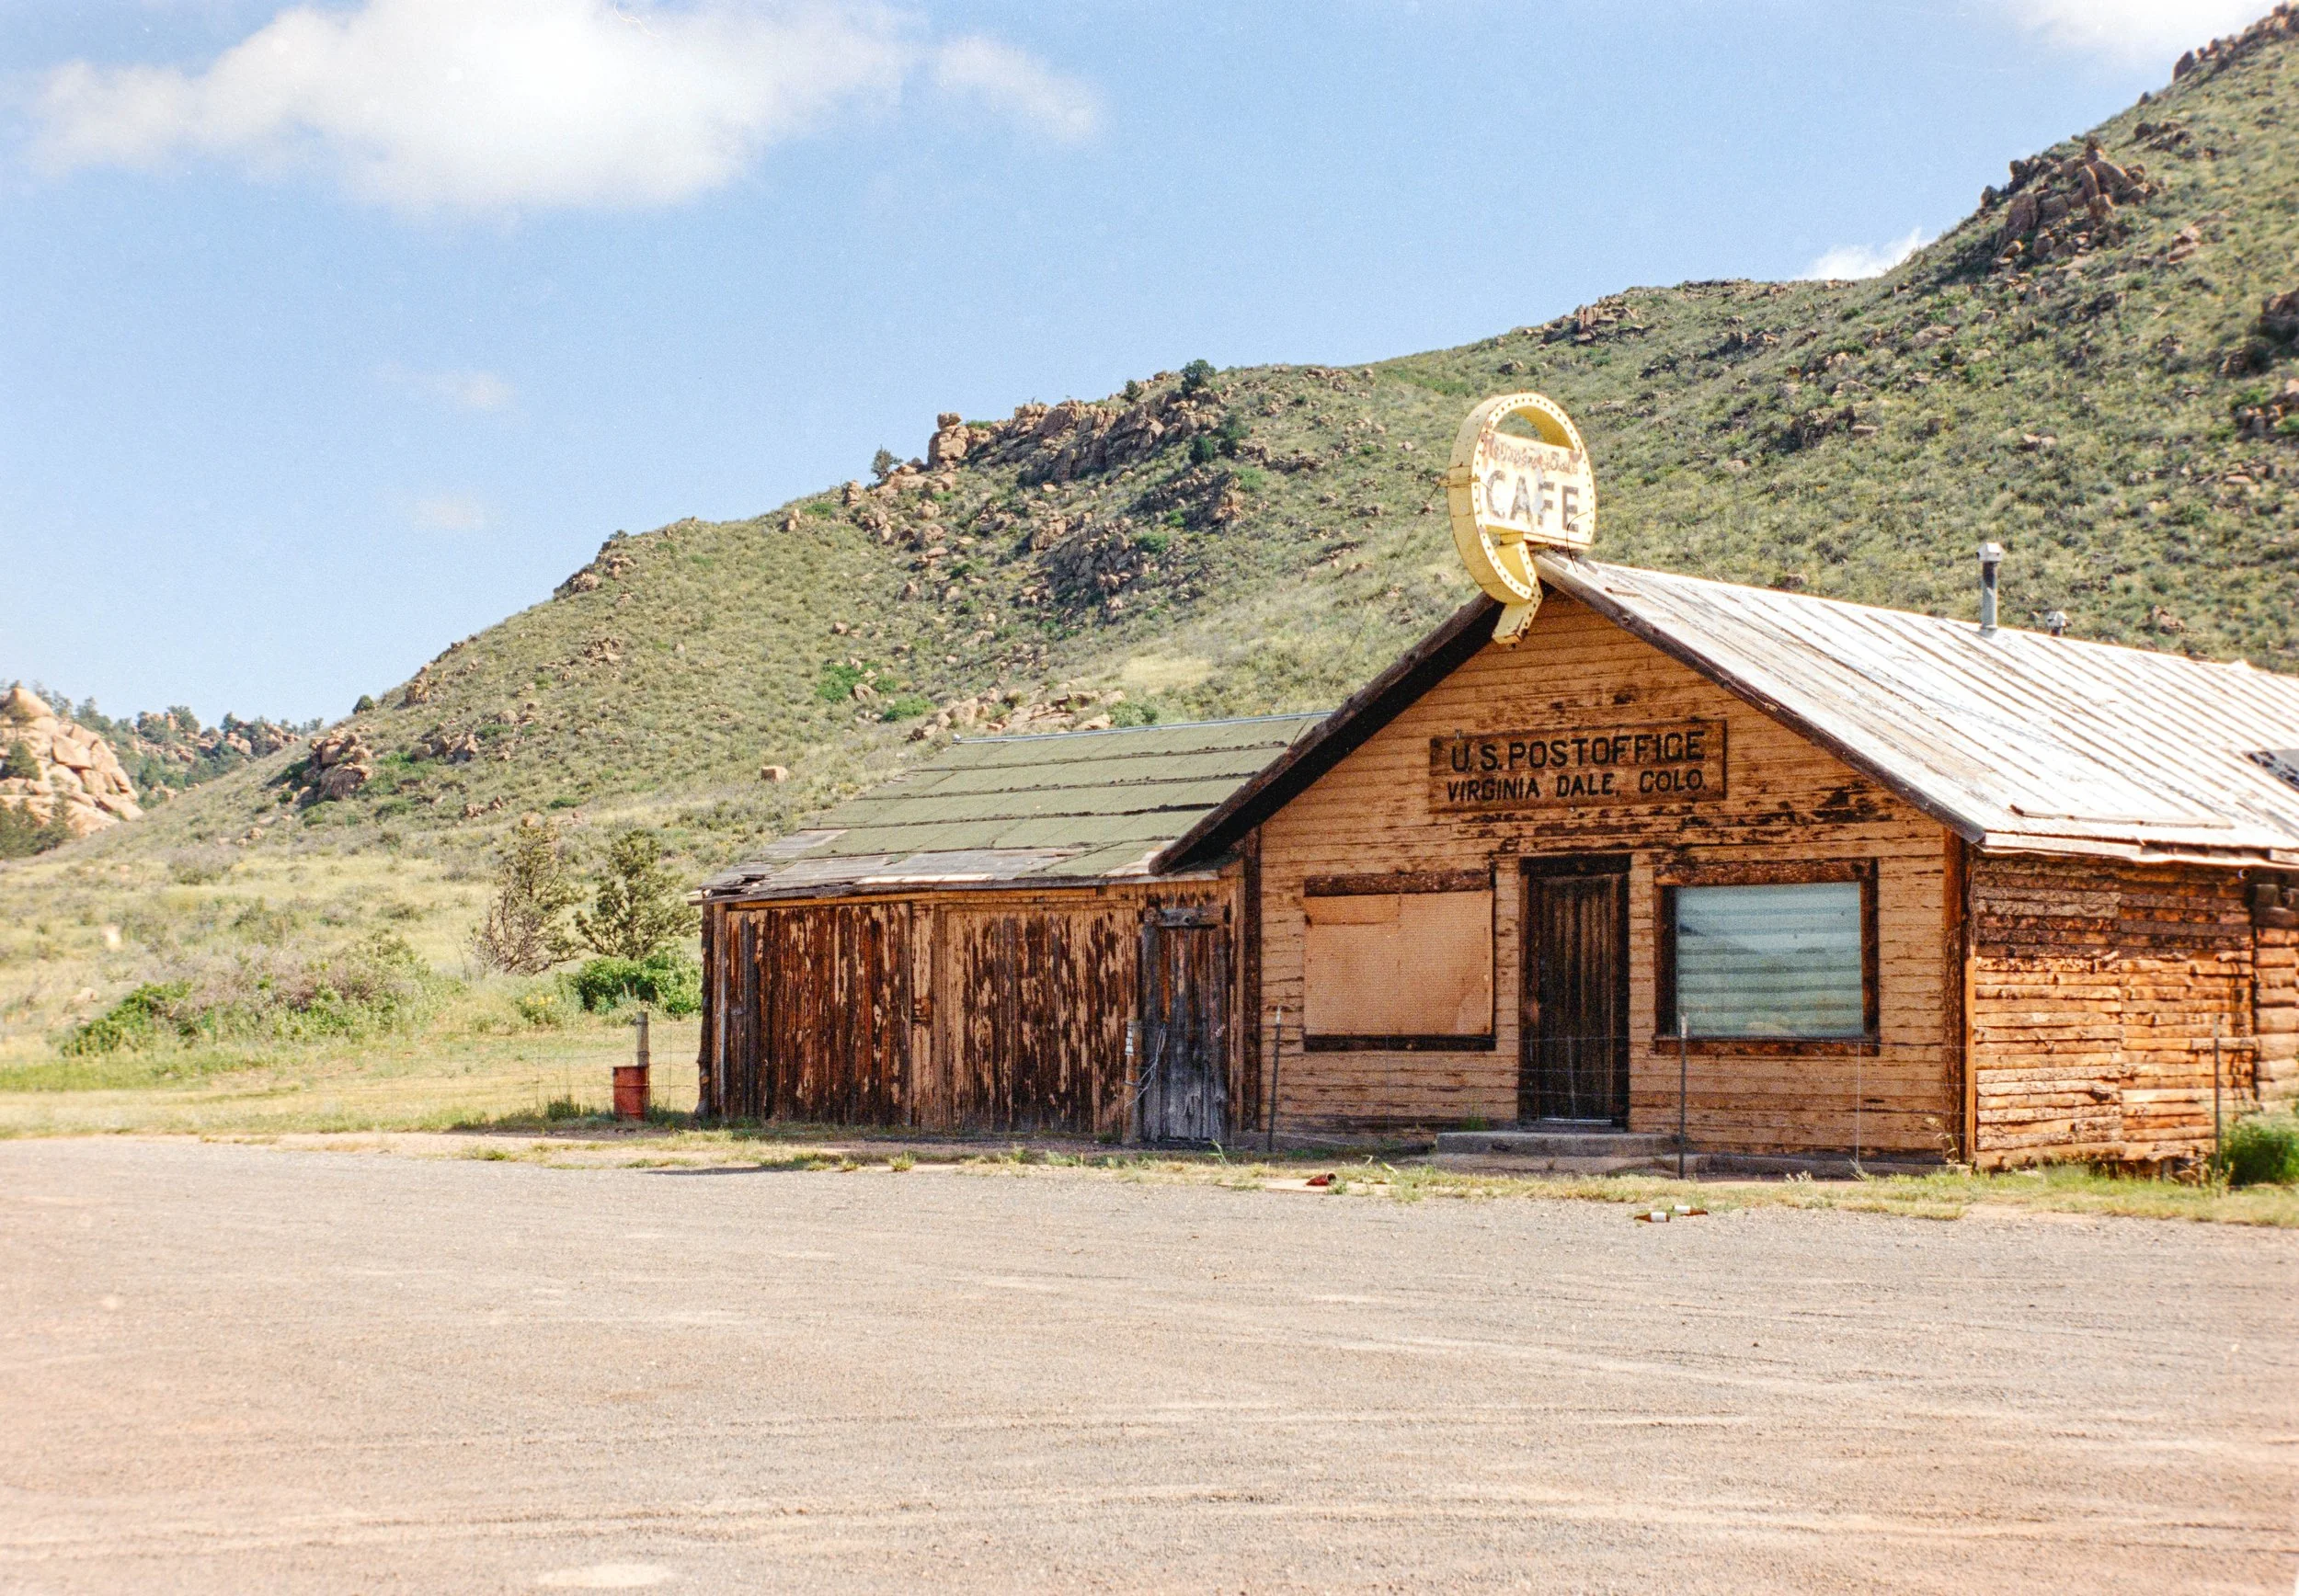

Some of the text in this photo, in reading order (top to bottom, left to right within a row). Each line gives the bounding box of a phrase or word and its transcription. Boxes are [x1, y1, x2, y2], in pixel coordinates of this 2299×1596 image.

[1486, 470, 1579, 532] CAFE
[1447, 769, 1707, 803] VIRGINIA DALE, COLO.
